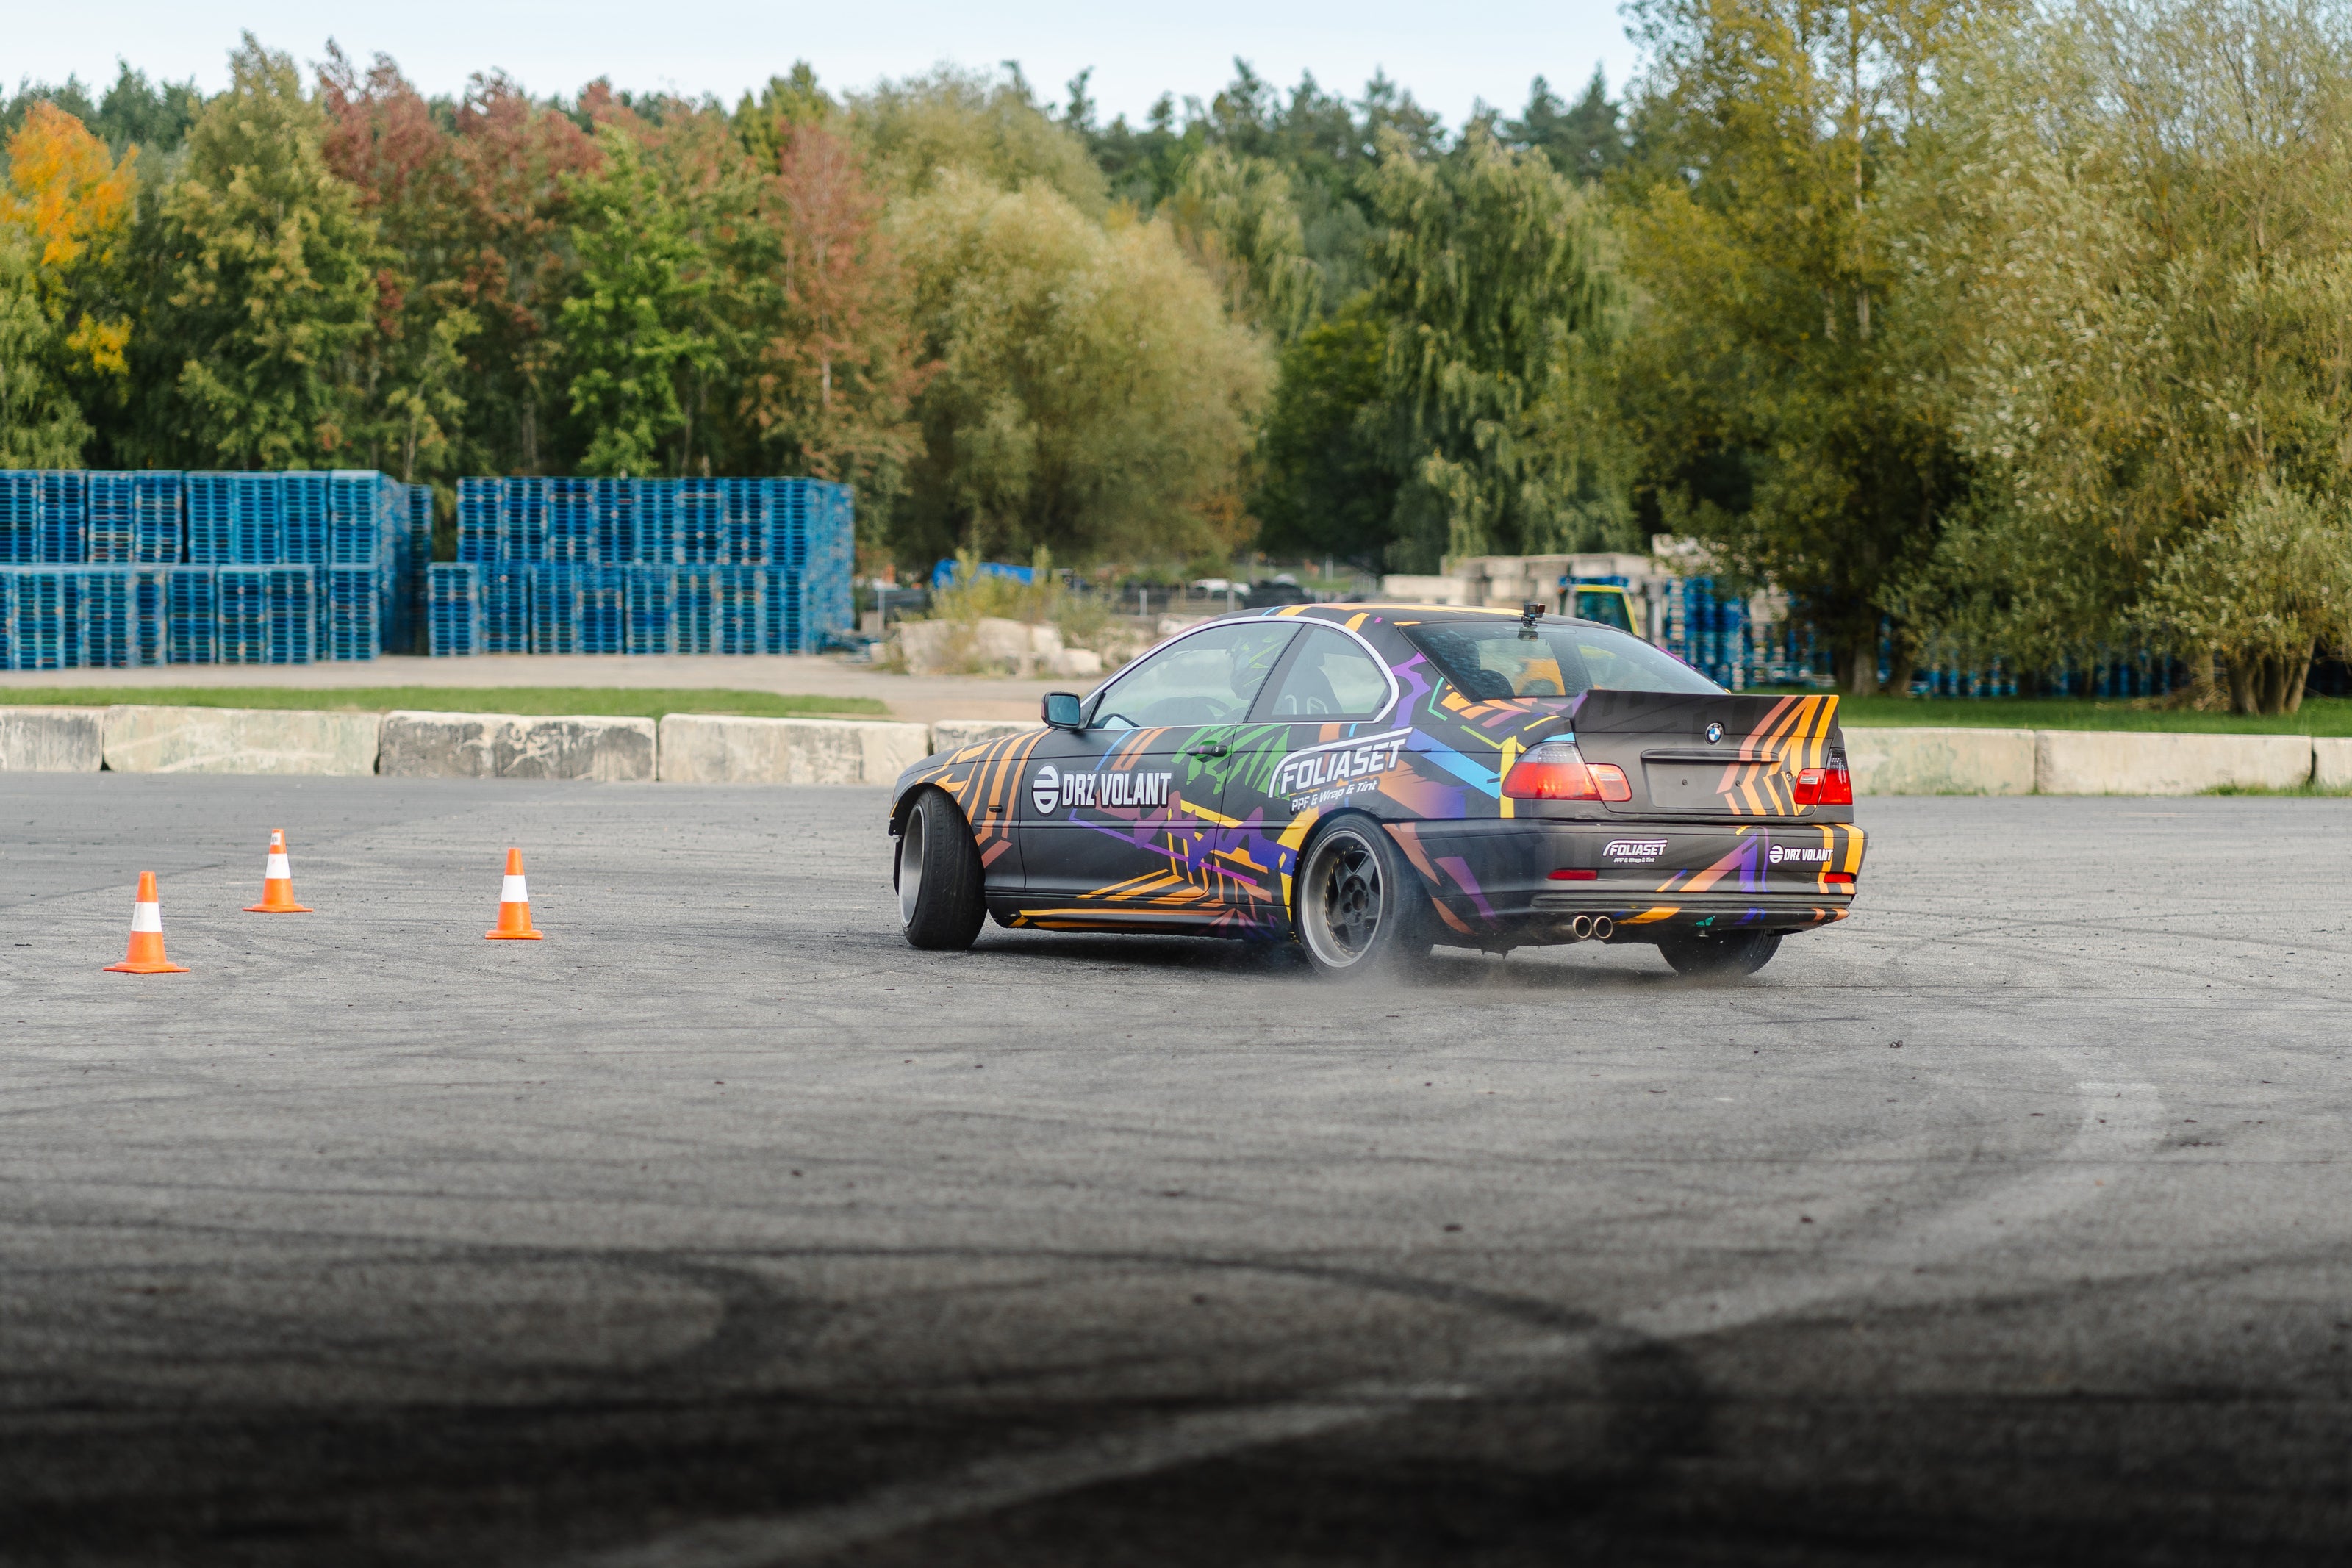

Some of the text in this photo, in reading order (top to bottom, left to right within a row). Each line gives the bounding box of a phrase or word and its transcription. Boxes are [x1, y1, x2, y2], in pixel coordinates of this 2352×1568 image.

[1280, 738, 1406, 794] FOLIASET
[1101, 772, 1172, 805] VOLANT
[1291, 780, 1378, 811] PPF & Wrap & Tint
[1609, 844, 1666, 856] FOLIASET
[1801, 849, 1834, 861] VOLANT
